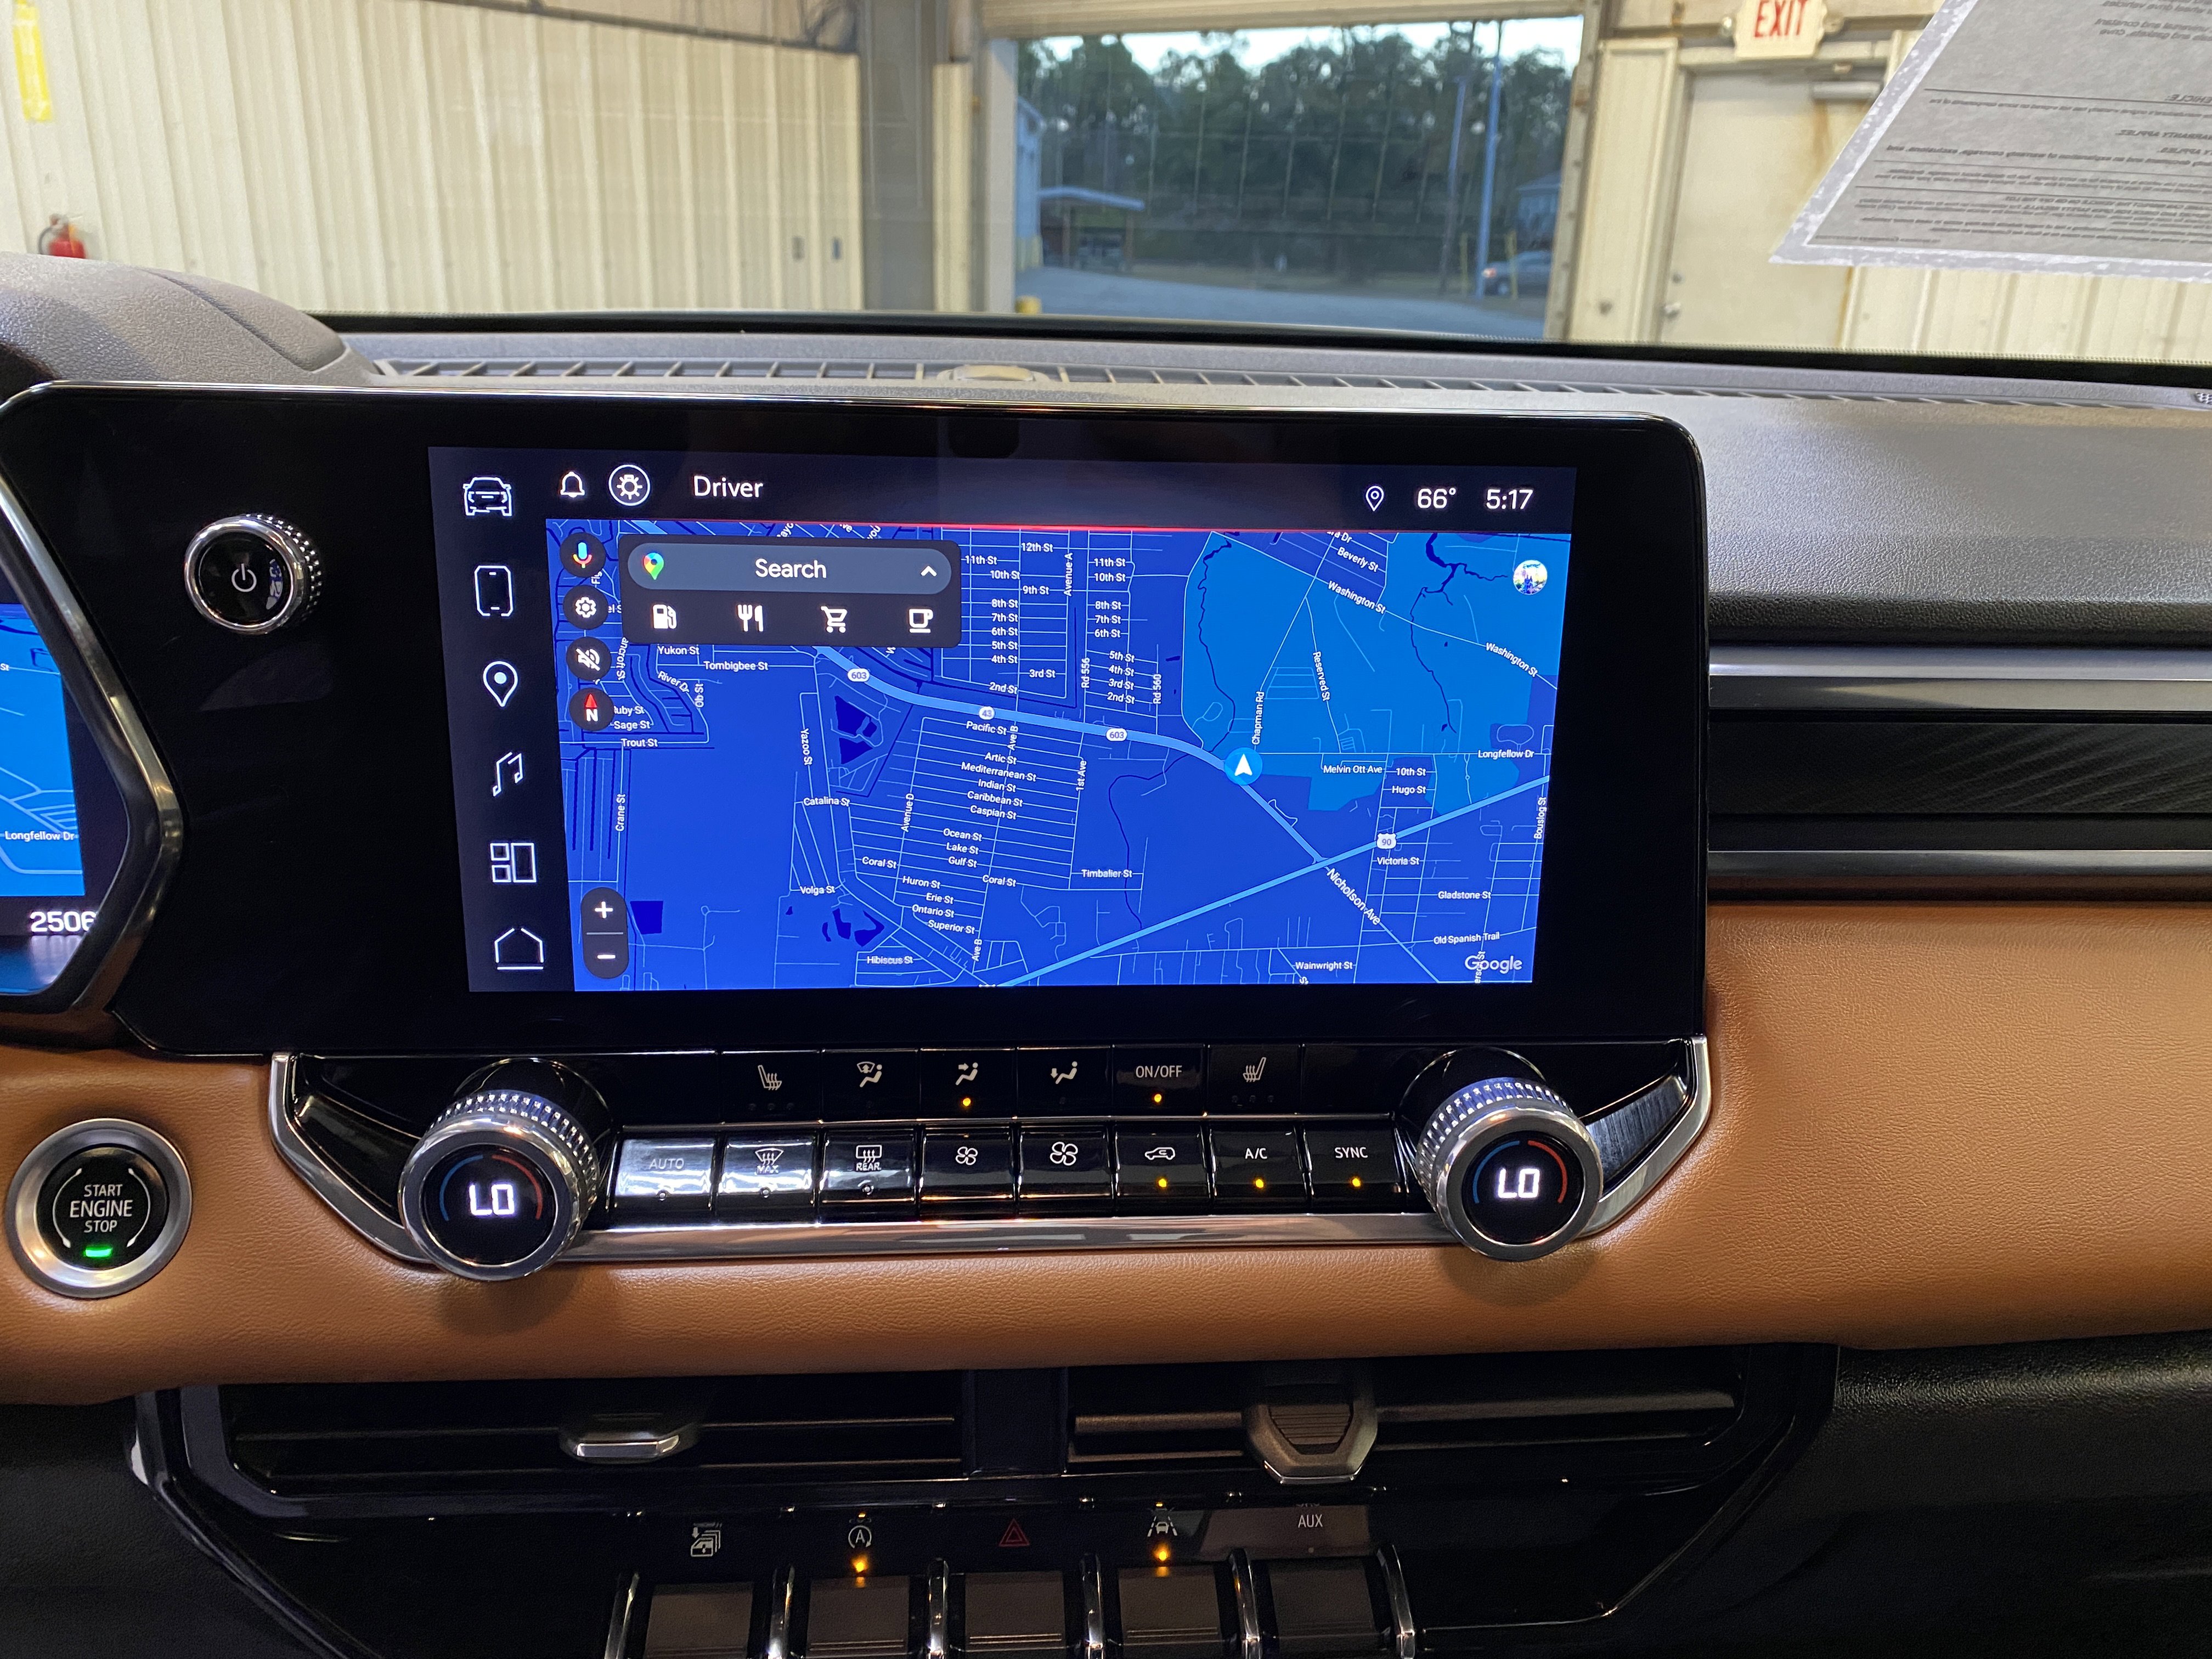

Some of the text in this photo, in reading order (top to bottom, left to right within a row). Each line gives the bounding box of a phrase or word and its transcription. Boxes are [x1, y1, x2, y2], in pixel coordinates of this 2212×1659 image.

[1754, 0, 1809, 37] EXIT
[693, 475, 764, 498] Driver
[1486, 489, 1533, 510] 5:17
[1022, 542, 1053, 552] 12th St
[965, 555, 997, 565] 11th St
[1094, 557, 1126, 567] 11th St
[1338, 546, 1379, 572] Beverly St
[755, 558, 827, 578] Search
[990, 570, 1020, 579] 10th St
[1063, 562, 1073, 596] Avenue
[1094, 572, 1126, 582] 10th St
[1023, 585, 1049, 595] 9th St
[991, 599, 1018, 608] 8th St
[1328, 580, 1386, 614] Washington St
[1095, 601, 1121, 610] 8th St
[991, 613, 1018, 622] 7th St
[1095, 614, 1121, 624] 7th St
[991, 627, 1018, 636] 6th St
[657, 646, 699, 655] Yukon St
[992, 641, 1018, 650] 5th St
[991, 654, 1018, 664] 4th St
[1486, 642, 1538, 677] Washington St
[703, 661, 768, 672] Tombigbee St
[1081, 657, 1090, 688] Rd 556
[1029, 669, 1056, 678] 3rd St
[1313, 651, 1330, 701] Reserved St
[988, 682, 1018, 695] 2nd St
[586, 708, 599, 721] N
[1251, 691, 1265, 744] Chapman Rd
[614, 720, 650, 731] Sage St
[966, 721, 1007, 735] Pacific St
[620, 738, 658, 747] Trout St
[800, 728, 812, 765] Yazoo St
[1007, 734, 1017, 751] Ave
[985, 752, 1017, 765] Artic St
[1478, 749, 1534, 760] Longfellow Dr
[961, 761, 1036, 782] Mediterranean St
[1076, 760, 1087, 791] 1st Ave
[1323, 765, 1351, 773] Melvin
[1352, 765, 1369, 773] Ott
[1396, 768, 1426, 776] 10th St
[978, 778, 1016, 792] Indian St
[1392, 786, 1426, 795] Hugo St
[803, 796, 850, 807] Catalina St
[967, 790, 1023, 807] Caribbean St
[615, 794, 625, 831] Crane St
[901, 801, 913, 832] Avenue
[970, 805, 1017, 820] Caspian St
[1533, 797, 1547, 839] Bouslog St
[5, 831, 74, 842] Longfellow Dr
[943, 828, 982, 842] Ocean St
[946, 842, 979, 854] Lake St
[862, 856, 896, 869] Coral St
[948, 856, 977, 868] Gulf St
[1377, 856, 1419, 865] Victoria St
[1081, 869, 1132, 877] Timbalier St
[902, 876, 940, 889] Huron St
[983, 874, 1016, 887] Coral St
[799, 885, 835, 896] Volga St
[1327, 868, 1380, 925] Nicholson Ave
[1438, 891, 1491, 899] Gladstone St
[926, 893, 953, 904] Erie St
[912, 904, 954, 918] Ontario St
[928, 919, 975, 934] Superior St
[1434, 932, 1500, 944] Old Spanish Trail
[867, 956, 913, 964] Hibiscus St
[1295, 961, 1353, 971] Wainwright St
[1465, 955, 1522, 974] Google
[1135, 1065, 1183, 1079] ON/OFF
[1244, 1148, 1268, 1160] A/C
[1334, 1147, 1369, 1159] SYNC
[650, 1158, 685, 1171] AUTO
[757, 1164, 780, 1175] MAX
[855, 1162, 880, 1172] REAR
[1497, 1167, 1541, 1199] LO
[83, 1184, 123, 1198] START
[469, 1182, 516, 1217] LO
[69, 1199, 133, 1218] ENGINE
[83, 1220, 118, 1233] STOP
[1297, 1514, 1323, 1528] AUX
